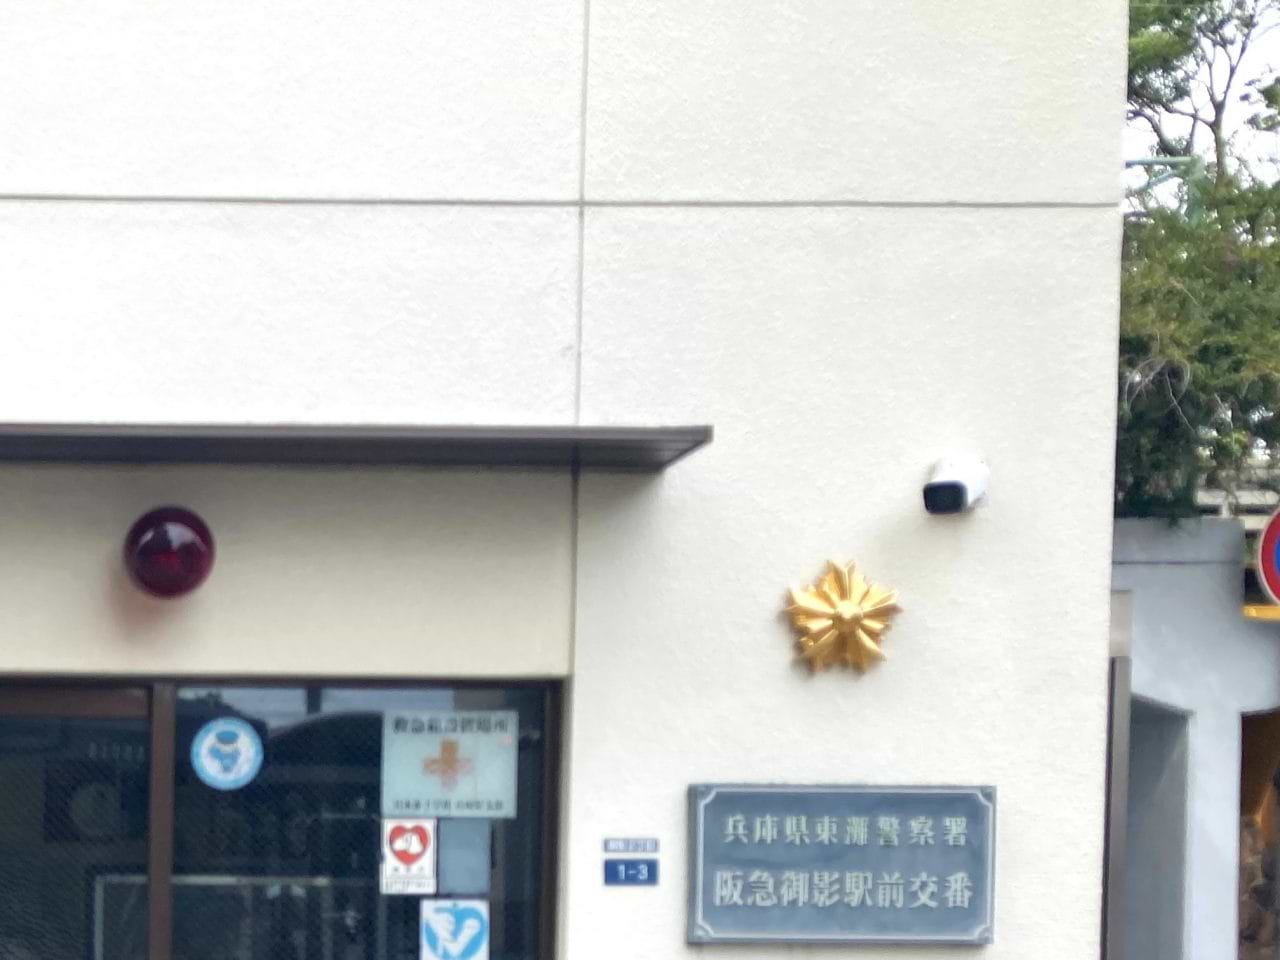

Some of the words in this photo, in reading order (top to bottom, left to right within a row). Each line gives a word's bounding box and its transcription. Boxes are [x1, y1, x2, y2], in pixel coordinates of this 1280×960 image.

[723, 813, 967, 847] 兵庫県東灘警察署
[617, 864, 649, 881] 1-3
[713, 868, 974, 909] 阪急御影駅前交番
